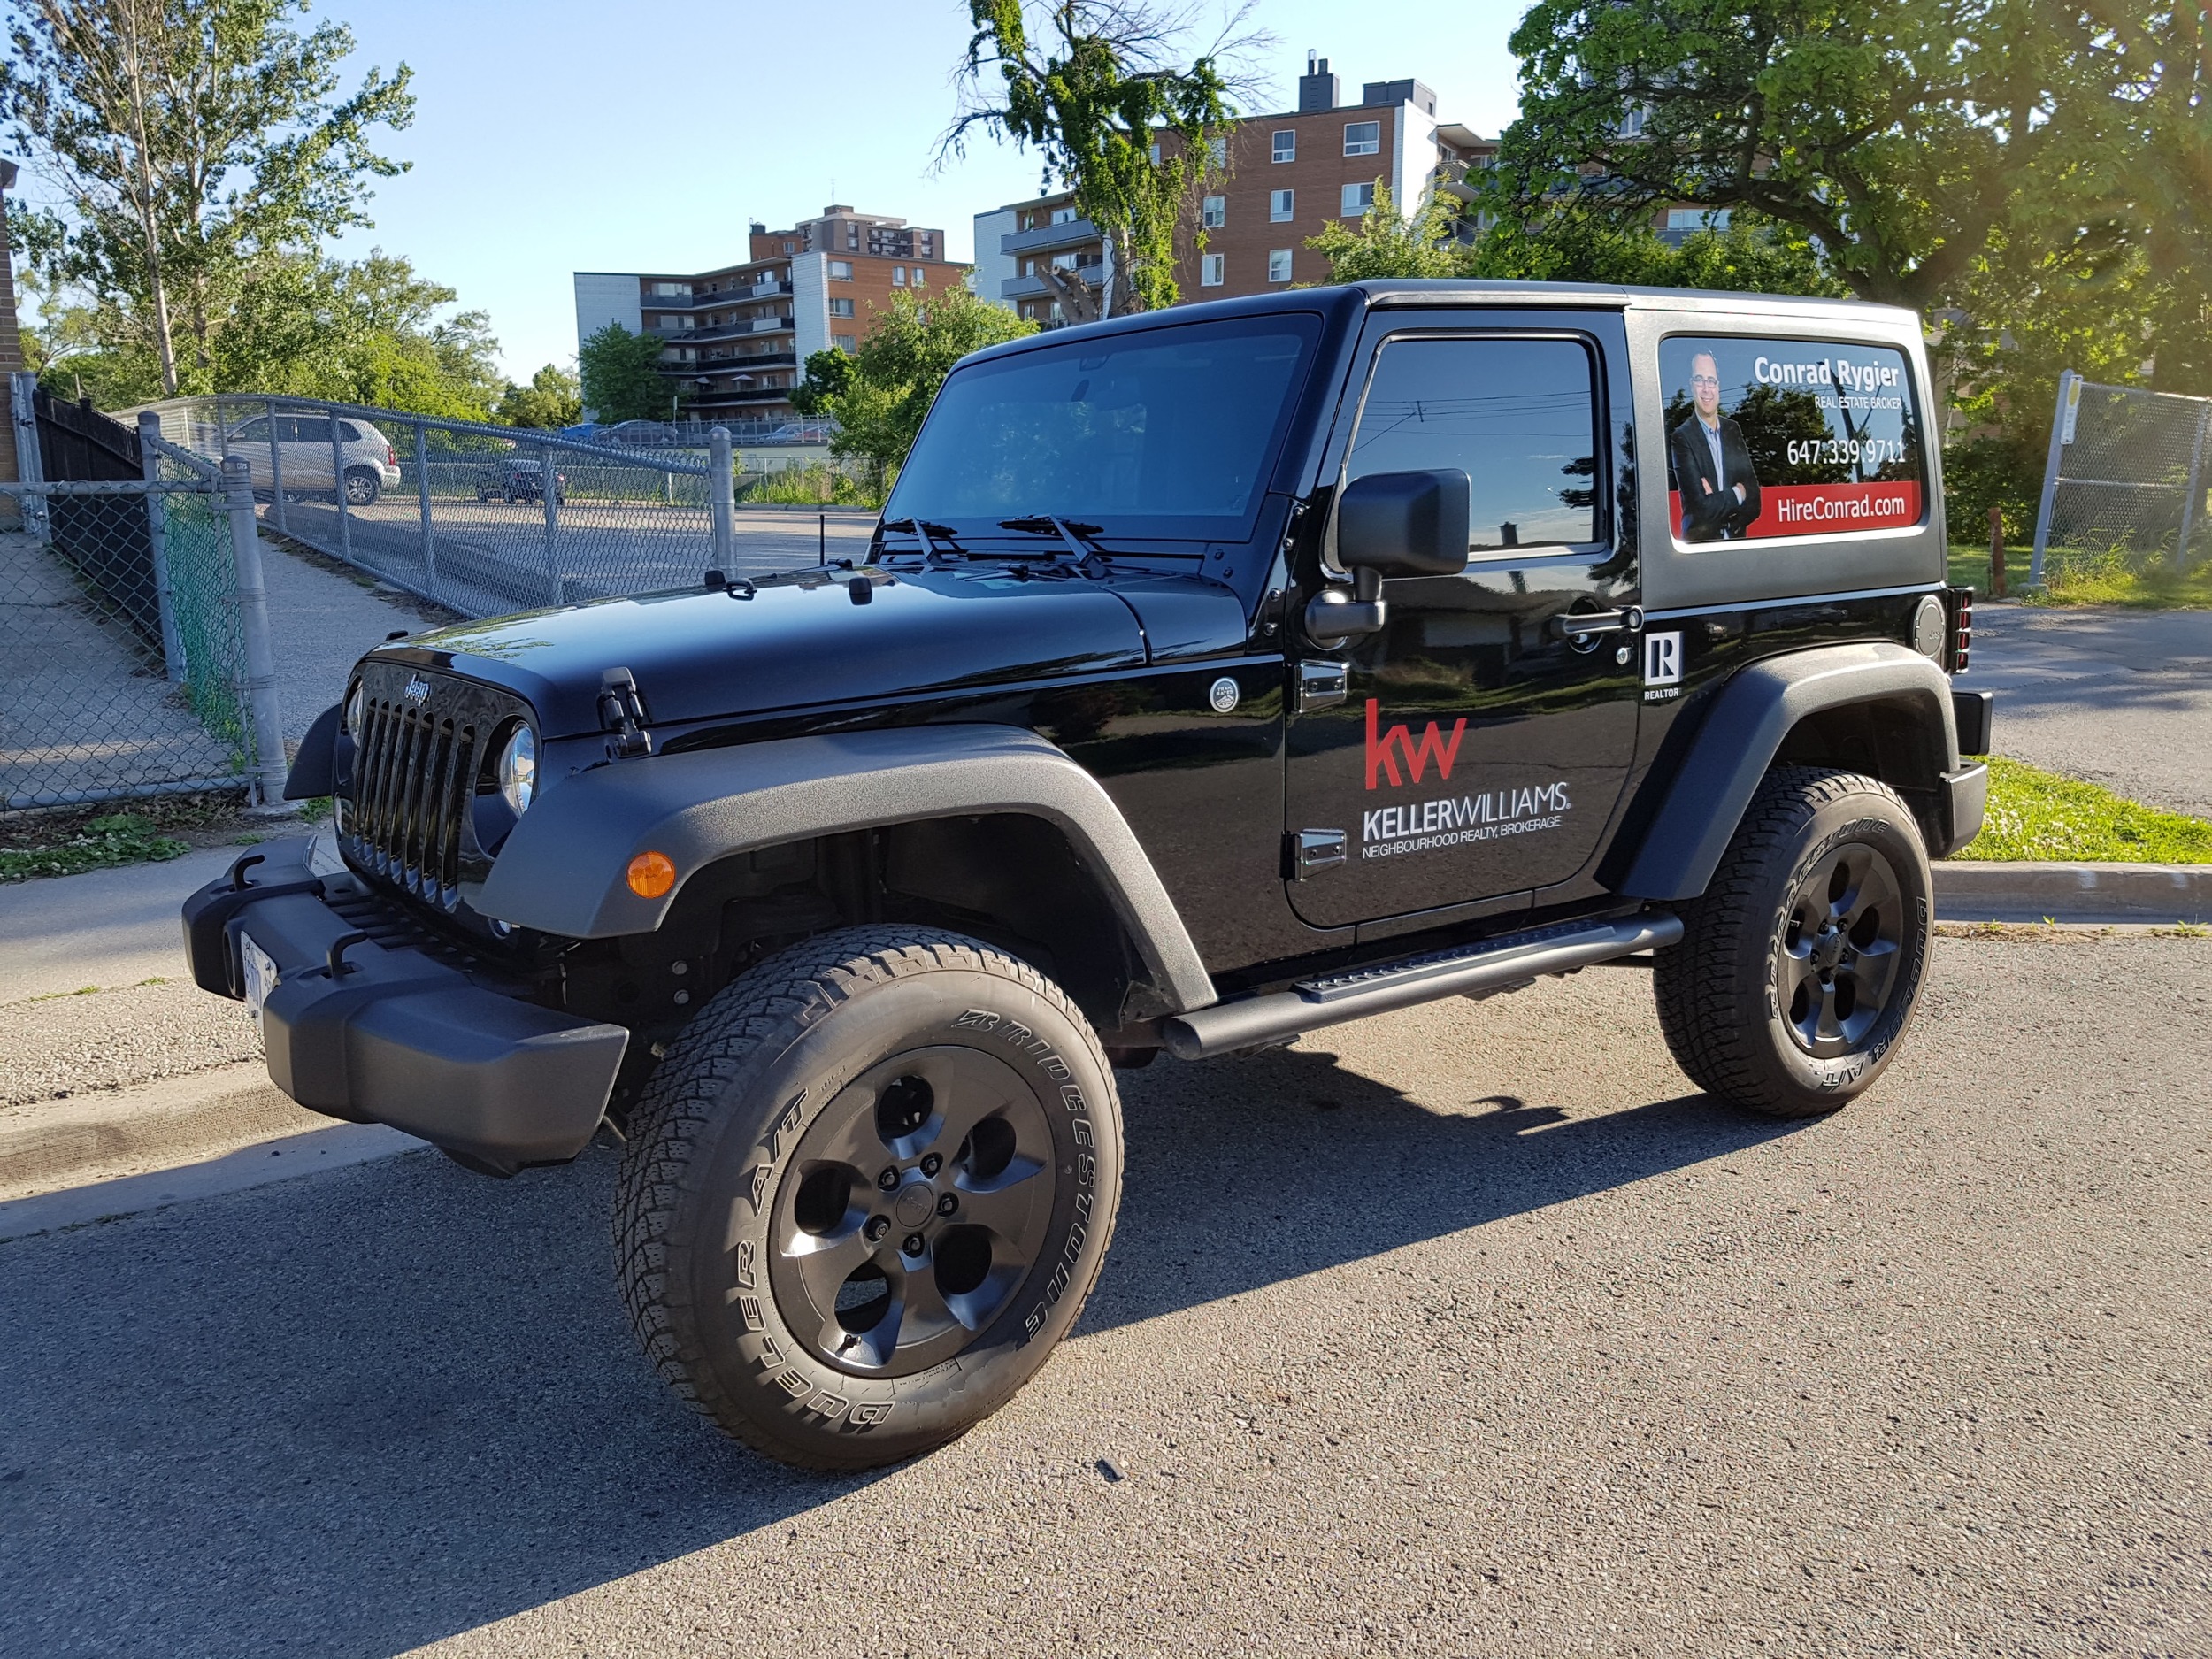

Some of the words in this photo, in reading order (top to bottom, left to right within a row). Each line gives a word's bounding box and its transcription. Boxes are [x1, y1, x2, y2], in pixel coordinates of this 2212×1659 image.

[1755, 357, 1836, 384] Conrad
[1838, 359, 1899, 392] Rygier
[1815, 396, 1837, 409] REAL
[1839, 396, 1869, 409] ESTATE
[1870, 397, 1902, 409] BROKER
[1787, 440, 1906, 465] 647.339.9711
[1778, 494, 1905, 522] HireConrad.com
[1644, 687, 1680, 700] REALTOR
[1365, 698, 1467, 790] kw
[1363, 833, 1459, 859] NEIGHBOURHOOD
[1460, 826, 1499, 843] REALTY,
[1500, 815, 1563, 837] BROKERAGE
[951, 1008, 1097, 1343] BRIDGESTONE
[738, 1240, 895, 1425] DUELER
